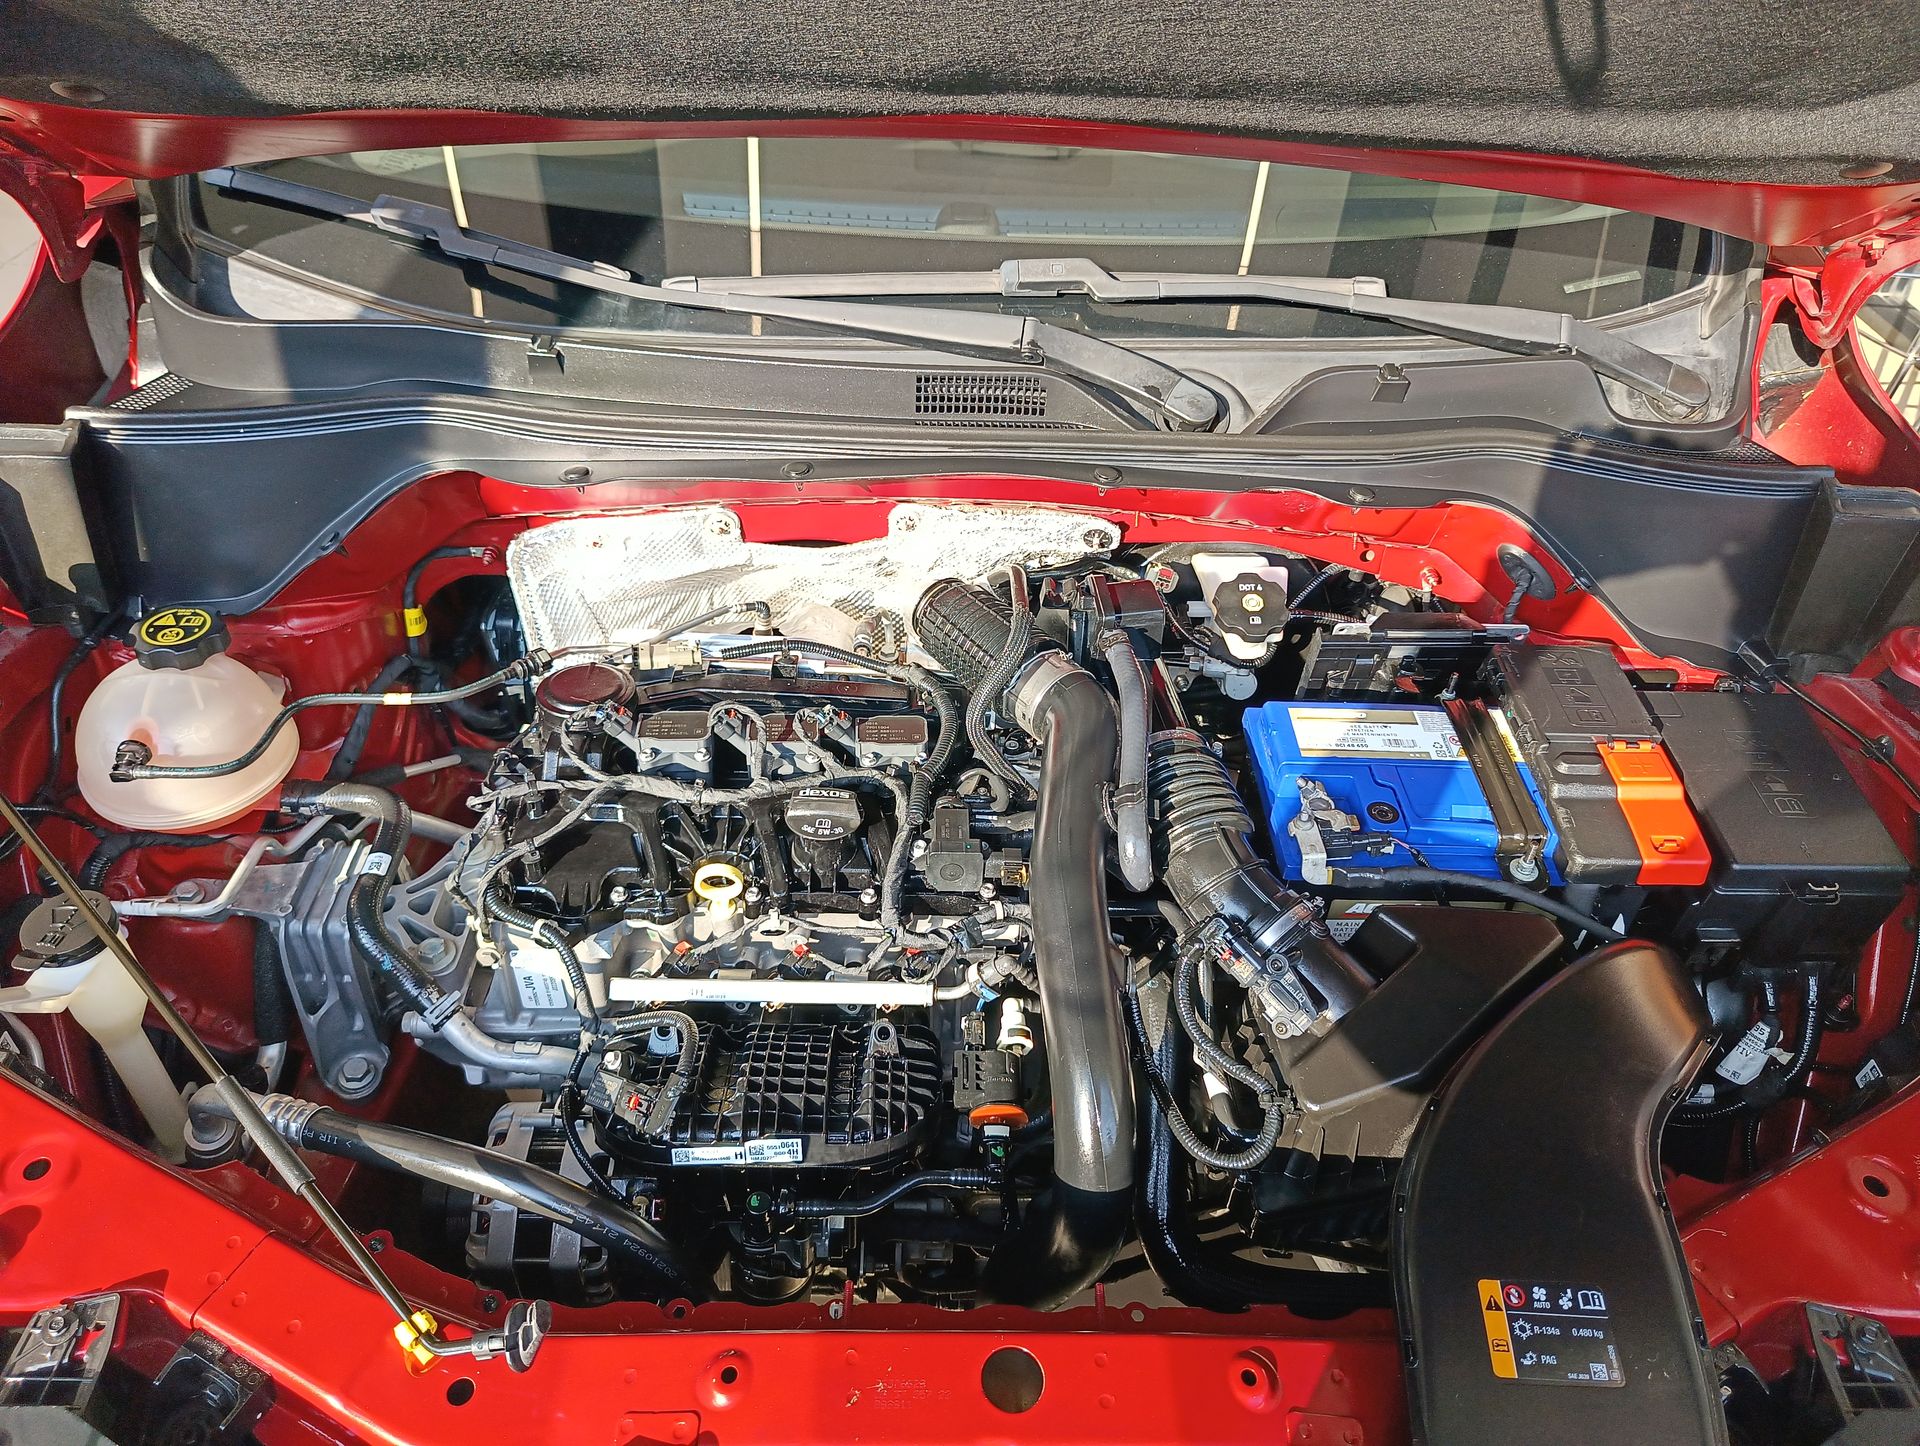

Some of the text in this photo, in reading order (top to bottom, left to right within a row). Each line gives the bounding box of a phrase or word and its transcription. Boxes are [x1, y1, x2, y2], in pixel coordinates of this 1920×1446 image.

[1238, 583, 1256, 591] DOT
[799, 788, 850, 799] dexos
[801, 824, 844, 835] SAE 5W-30
[523, 975, 536, 991] JVA
[1736, 1044, 1753, 1057] TIV
[735, 1151, 743, 1160] H
[1533, 1301, 1551, 1309] AUTO
[1533, 1325, 1560, 1336] R-134a
[1593, 1328, 1604, 1340] kg
[1540, 1355, 1557, 1365] PAG
